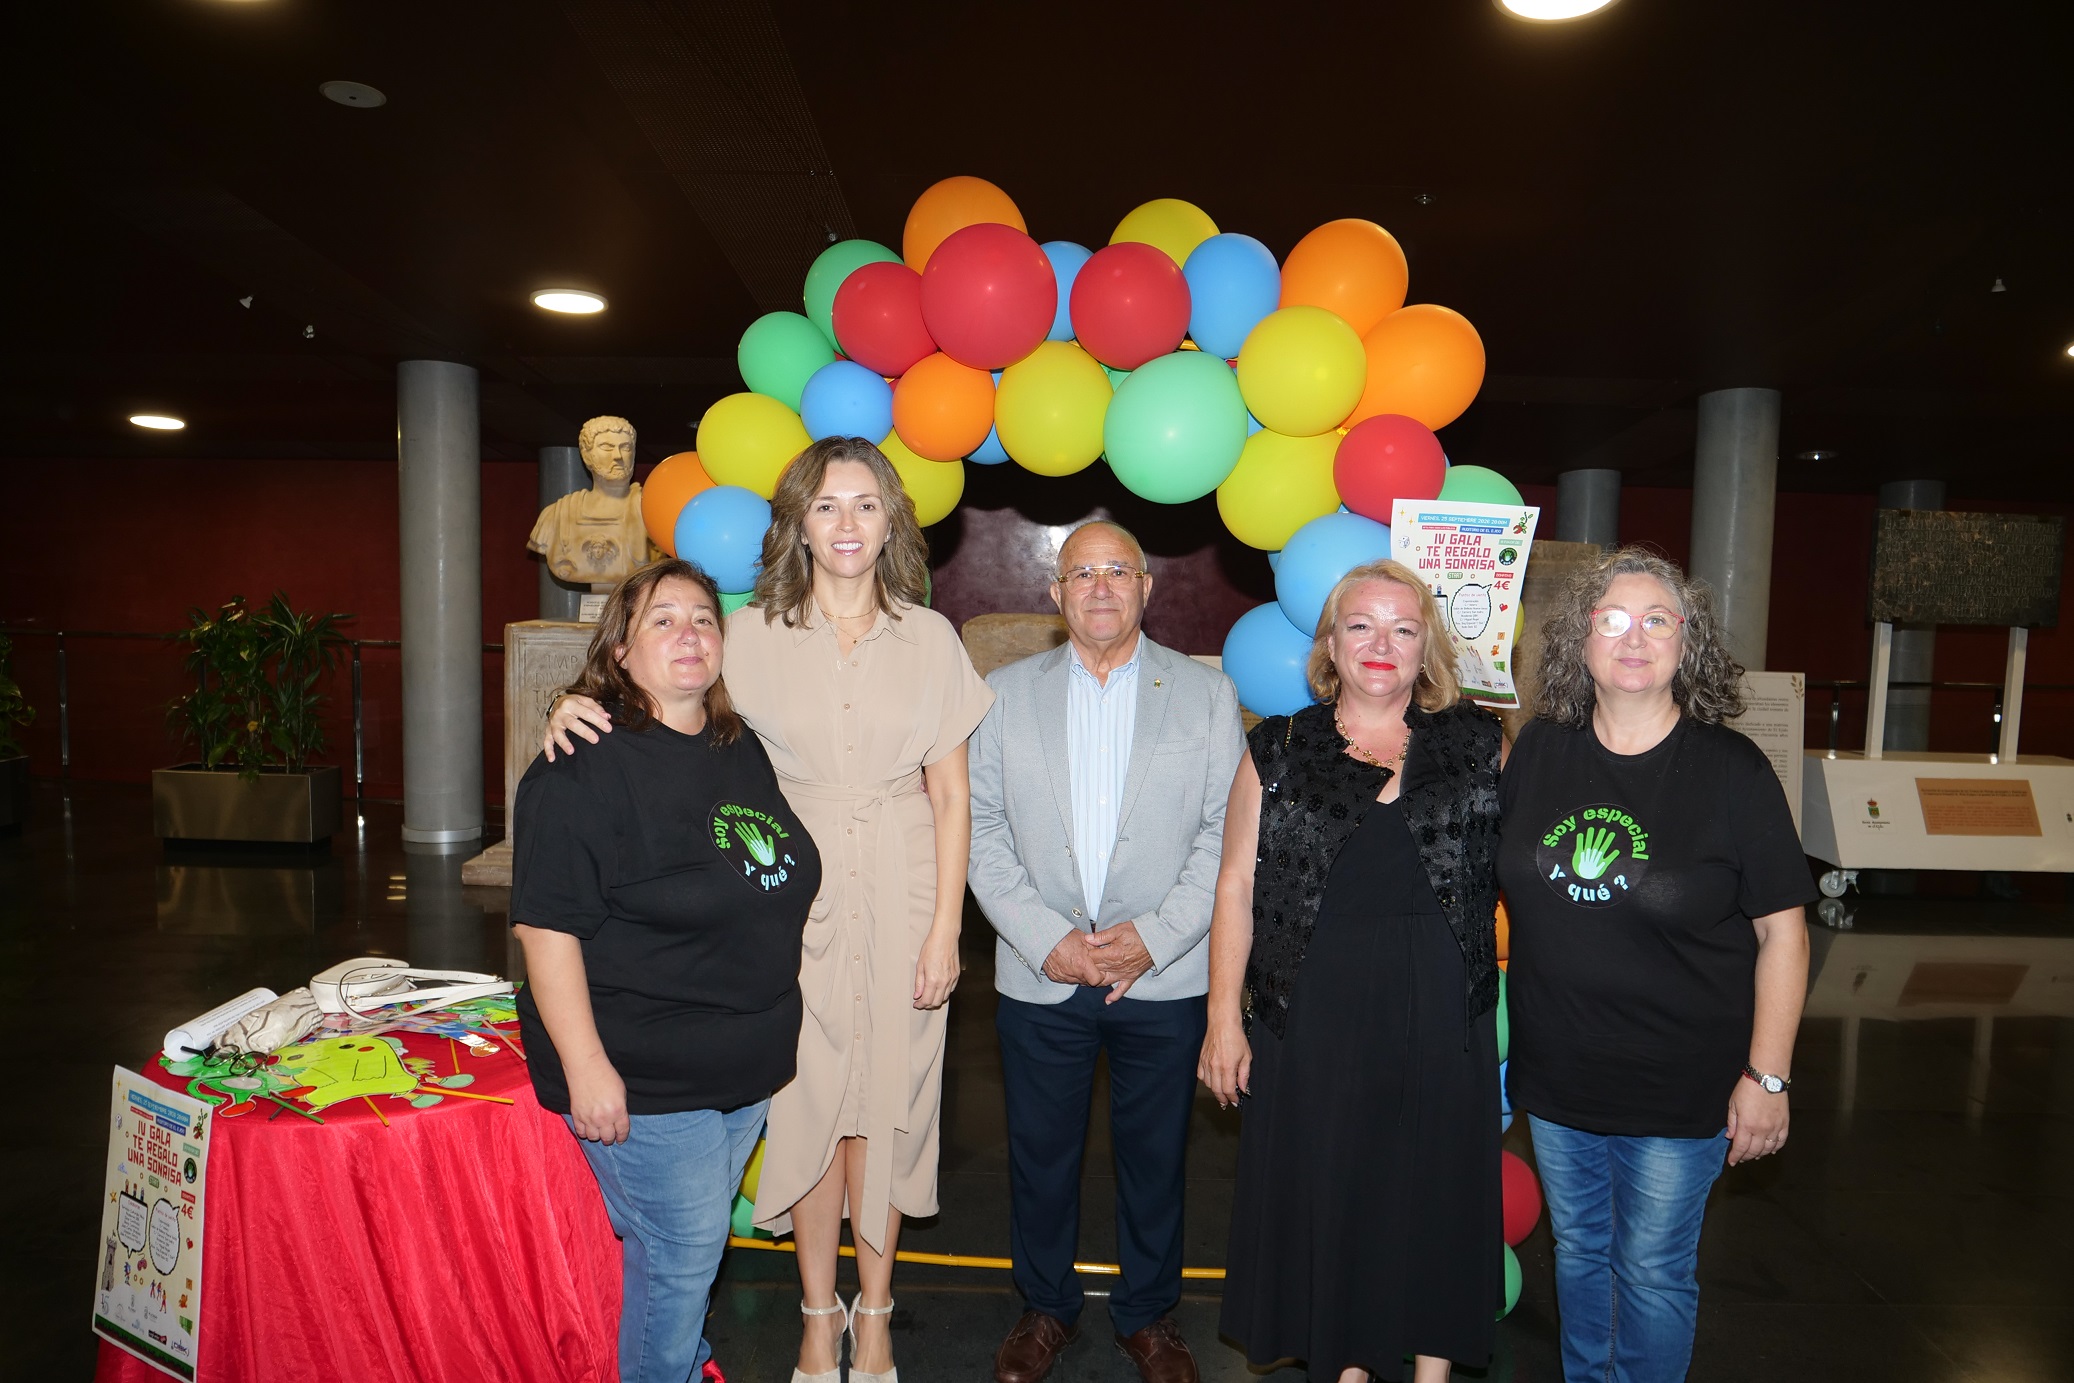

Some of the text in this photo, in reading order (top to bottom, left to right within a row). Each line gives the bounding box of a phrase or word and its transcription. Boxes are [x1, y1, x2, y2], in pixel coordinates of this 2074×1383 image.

[1427, 546, 1441, 557] TE
[1445, 546, 1491, 558] REGALO
[1434, 533, 1482, 546] IV GALA
[1419, 558, 1496, 570] UNA SONRISA
[1493, 580, 1511, 591] 4€
[714, 803, 790, 849] Soy especial
[1542, 807, 1650, 860] Soy especial
[743, 853, 796, 891] Y qué ?
[1548, 863, 1629, 902] Y qué ?
[138, 1120, 171, 1148] IV GALA
[133, 1134, 144, 1152] TE
[146, 1139, 178, 1168] REGALO
[127, 1147, 145, 1168] UNA
[147, 1156, 182, 1187] SONRISA
[181, 1203, 194, 1220] 4€
